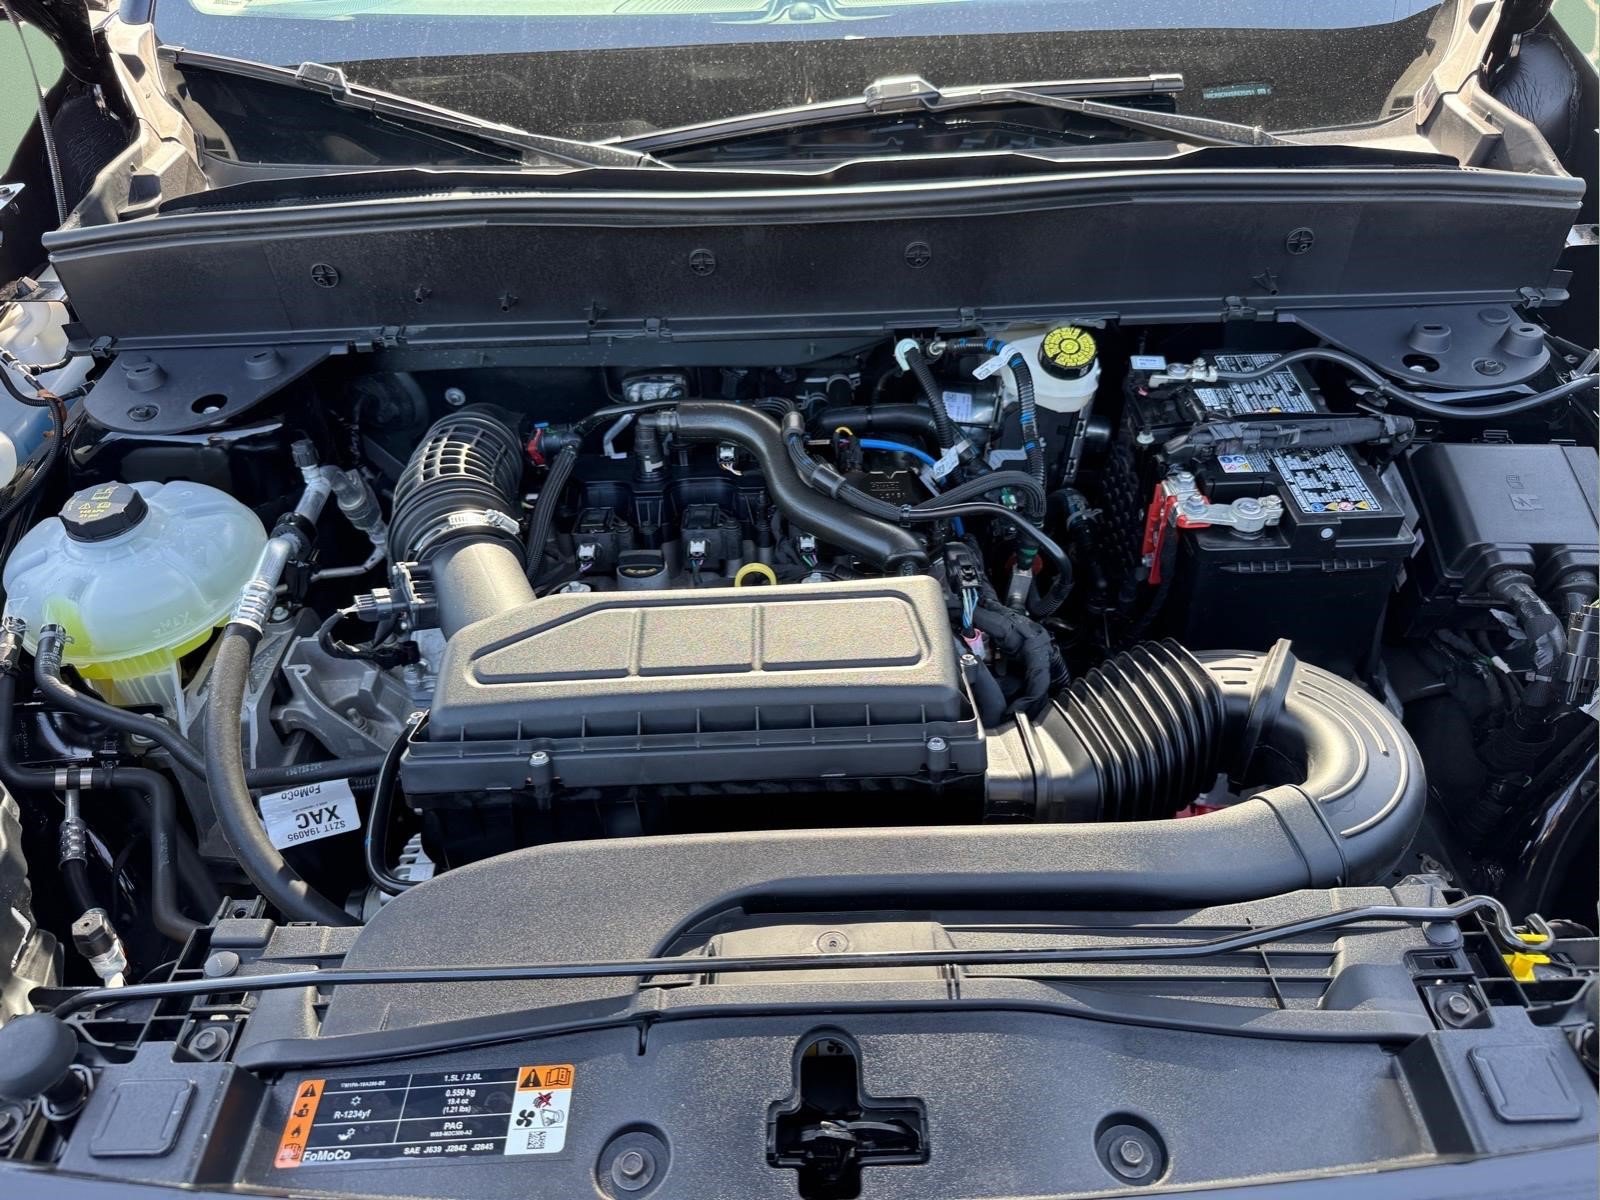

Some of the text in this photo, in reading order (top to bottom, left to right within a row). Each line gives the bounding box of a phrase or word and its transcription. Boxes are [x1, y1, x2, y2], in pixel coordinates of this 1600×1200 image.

[281, 784, 321, 800] FoMoCo
[295, 804, 340, 829] XAC
[287, 827, 320, 841] 19A095
[444, 1074, 460, 1082] 1.5L
[465, 1072, 482, 1081] 2.0L
[466, 1088, 476, 1098] kg
[333, 1109, 372, 1120] R-1234yf
[443, 1121, 464, 1130] PAG
[302, 1149, 351, 1161] FoMoCo
[403, 1146, 421, 1155] SAE
[423, 1145, 443, 1154] J639
